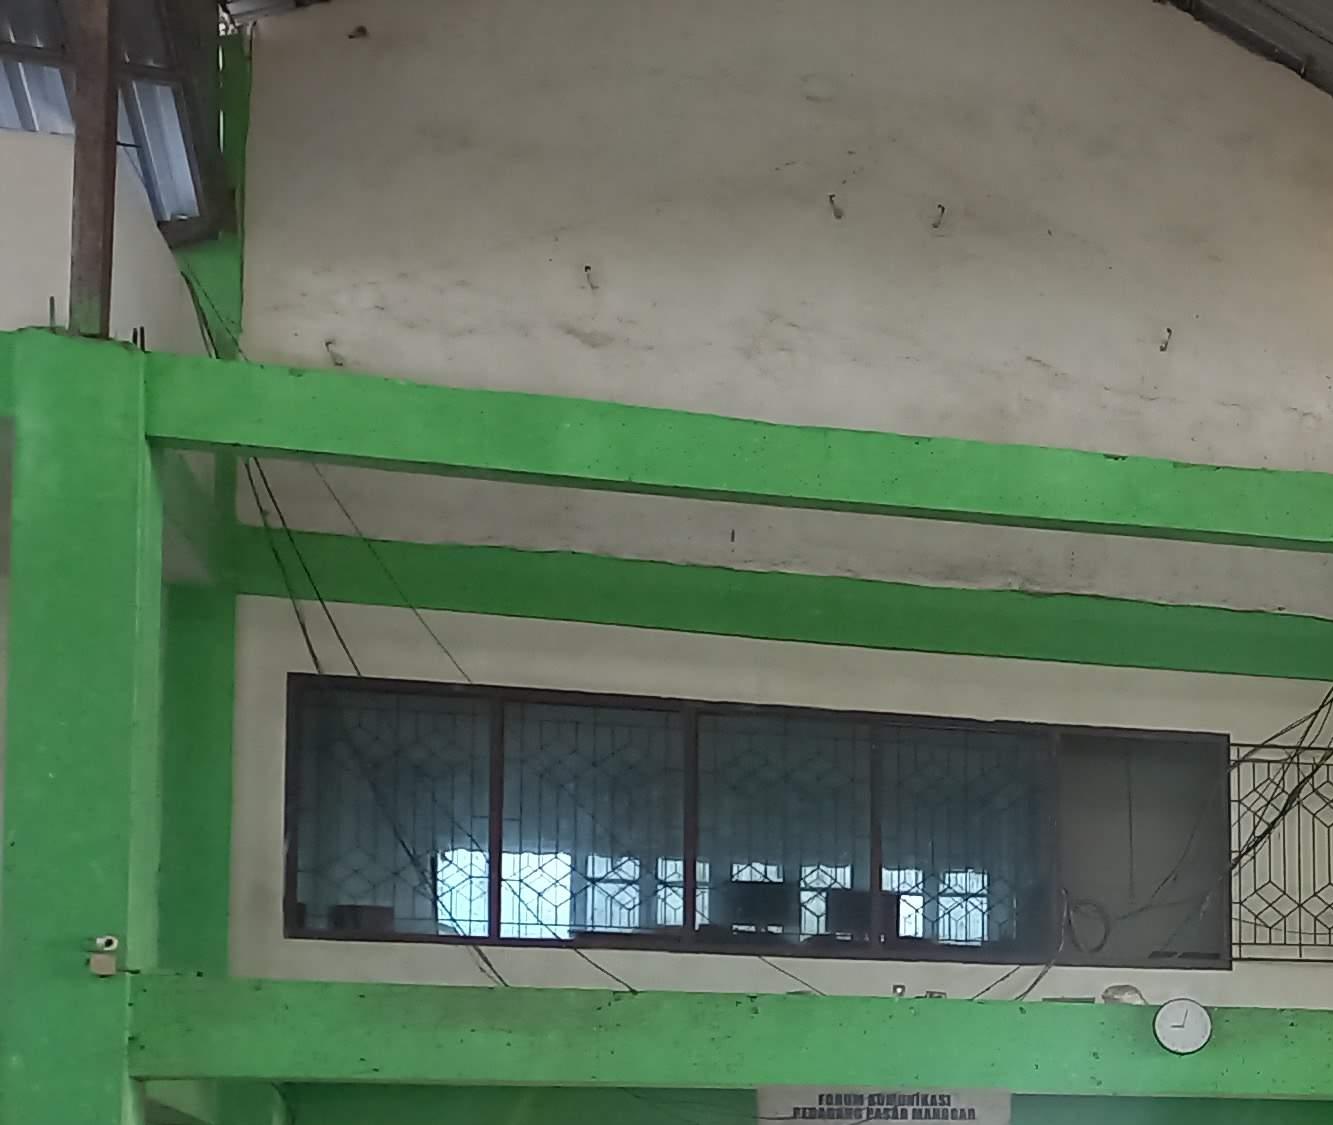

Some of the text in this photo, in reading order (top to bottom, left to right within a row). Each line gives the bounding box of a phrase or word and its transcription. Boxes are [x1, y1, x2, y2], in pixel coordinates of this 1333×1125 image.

[818, 1092, 952, 1107] FORUM KOMUNIKASI
[792, 1106, 863, 1120] PEDAGANG
[866, 1107, 909, 1120] PASAR
